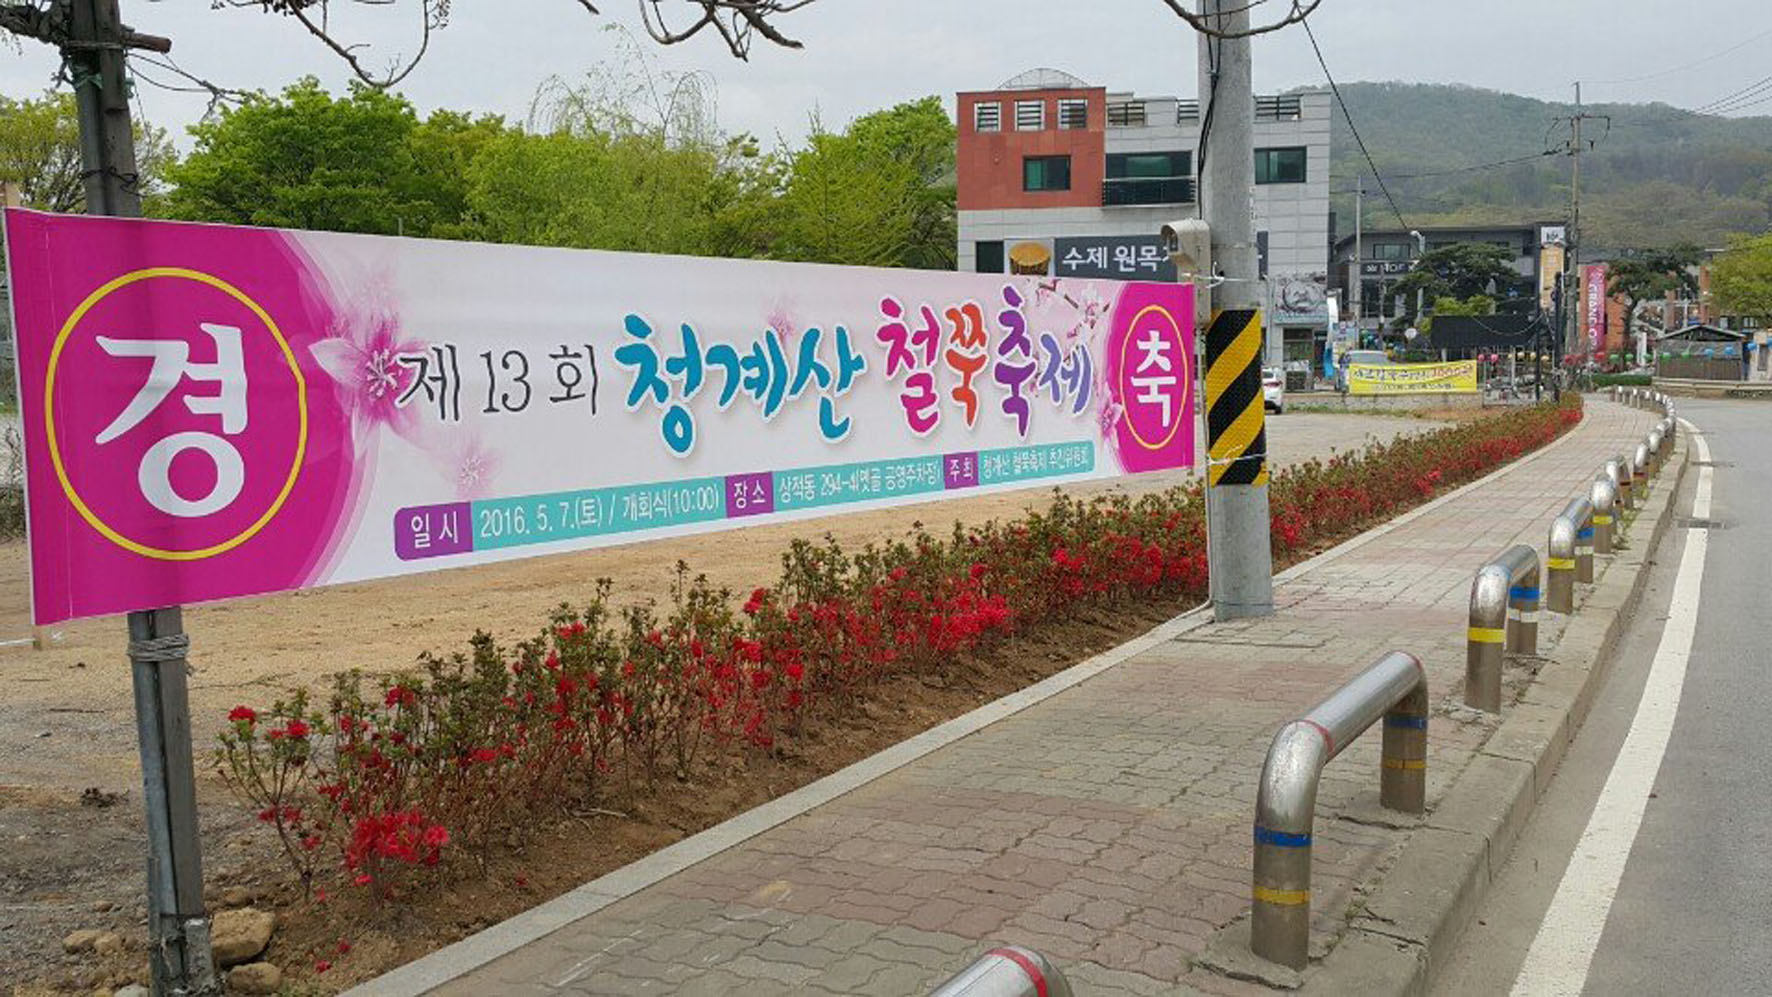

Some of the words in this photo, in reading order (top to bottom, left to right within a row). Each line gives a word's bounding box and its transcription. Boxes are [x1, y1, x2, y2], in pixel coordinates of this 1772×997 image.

[1062, 246, 1107, 270] 수제
[1112, 246, 1171, 272] 원목
[95, 323, 247, 516] 경
[398, 344, 460, 421] 제
[480, 349, 531, 413] 13
[548, 344, 599, 416] 회
[613, 313, 865, 453] 청계산
[1130, 329, 1176, 428] 축
[480, 506, 530, 538] 2016.
[537, 504, 553, 532] 5.
[623, 483, 719, 522] 개회식(10:00)
[779, 473, 816, 503] 상적동
